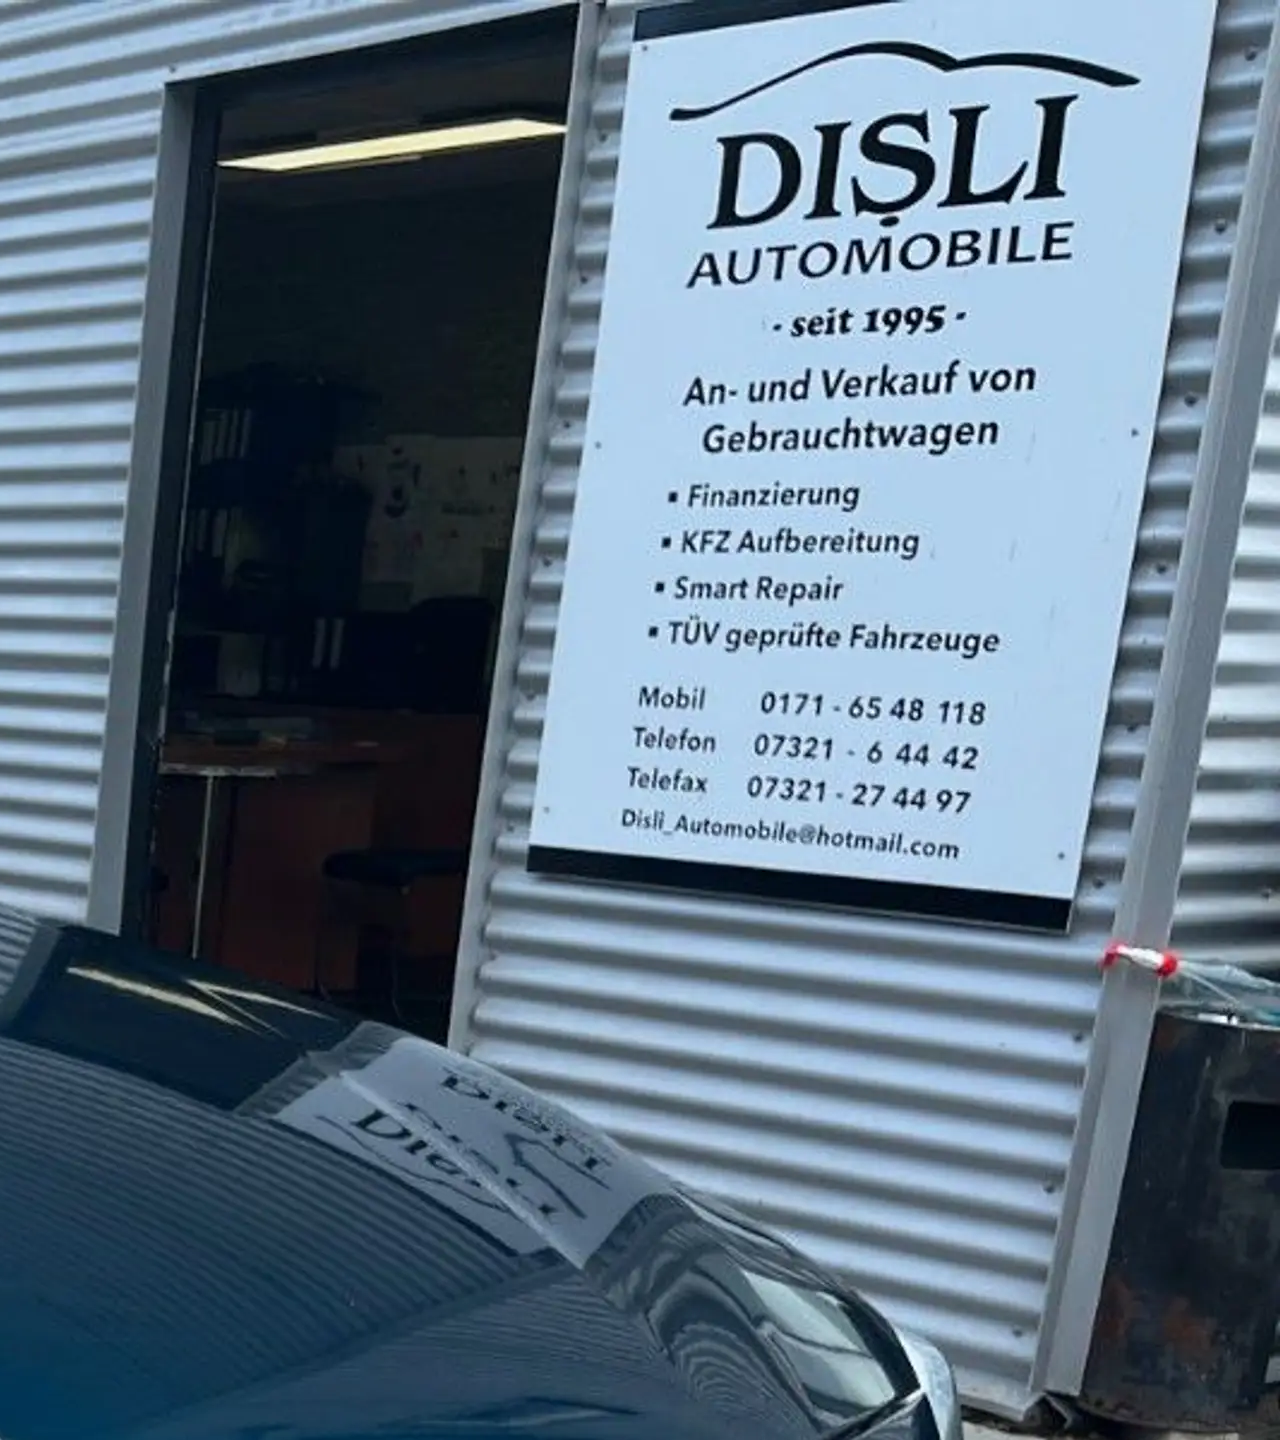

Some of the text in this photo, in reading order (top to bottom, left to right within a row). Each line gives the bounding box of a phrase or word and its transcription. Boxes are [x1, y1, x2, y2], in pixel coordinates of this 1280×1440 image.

[686, 221, 1075, 289] AUTOMOBILE
[790, 307, 855, 338] seit
[862, 304, 947, 337] 1995
[682, 358, 1037, 407] An- und Verkauf von
[702, 416, 999, 456] Gebrauchtwagen
[687, 481, 860, 513] Finanzierung
[681, 527, 920, 561] KFZ Aufbereitung
[674, 575, 844, 607] Smart Repair
[668, 615, 1001, 660] TÜV geprüfte Fahrzeuge
[638, 686, 706, 710] Mobil
[760, 691, 823, 716] 0171
[848, 696, 882, 720] 65
[889, 697, 924, 722] 48
[939, 700, 987, 726] 118
[633, 726, 716, 753] Telefon
[754, 733, 833, 761] 07321
[866, 741, 883, 764] 6
[895, 743, 929, 767] 44
[942, 745, 979, 770] 42
[627, 766, 707, 793] Telefax
[747, 775, 826, 803] 07321
[851, 783, 886, 807] 27
[892, 786, 927, 811] 44
[936, 789, 972, 814] 97
[621, 807, 960, 859] Disli_Automobile@hotmail.com
